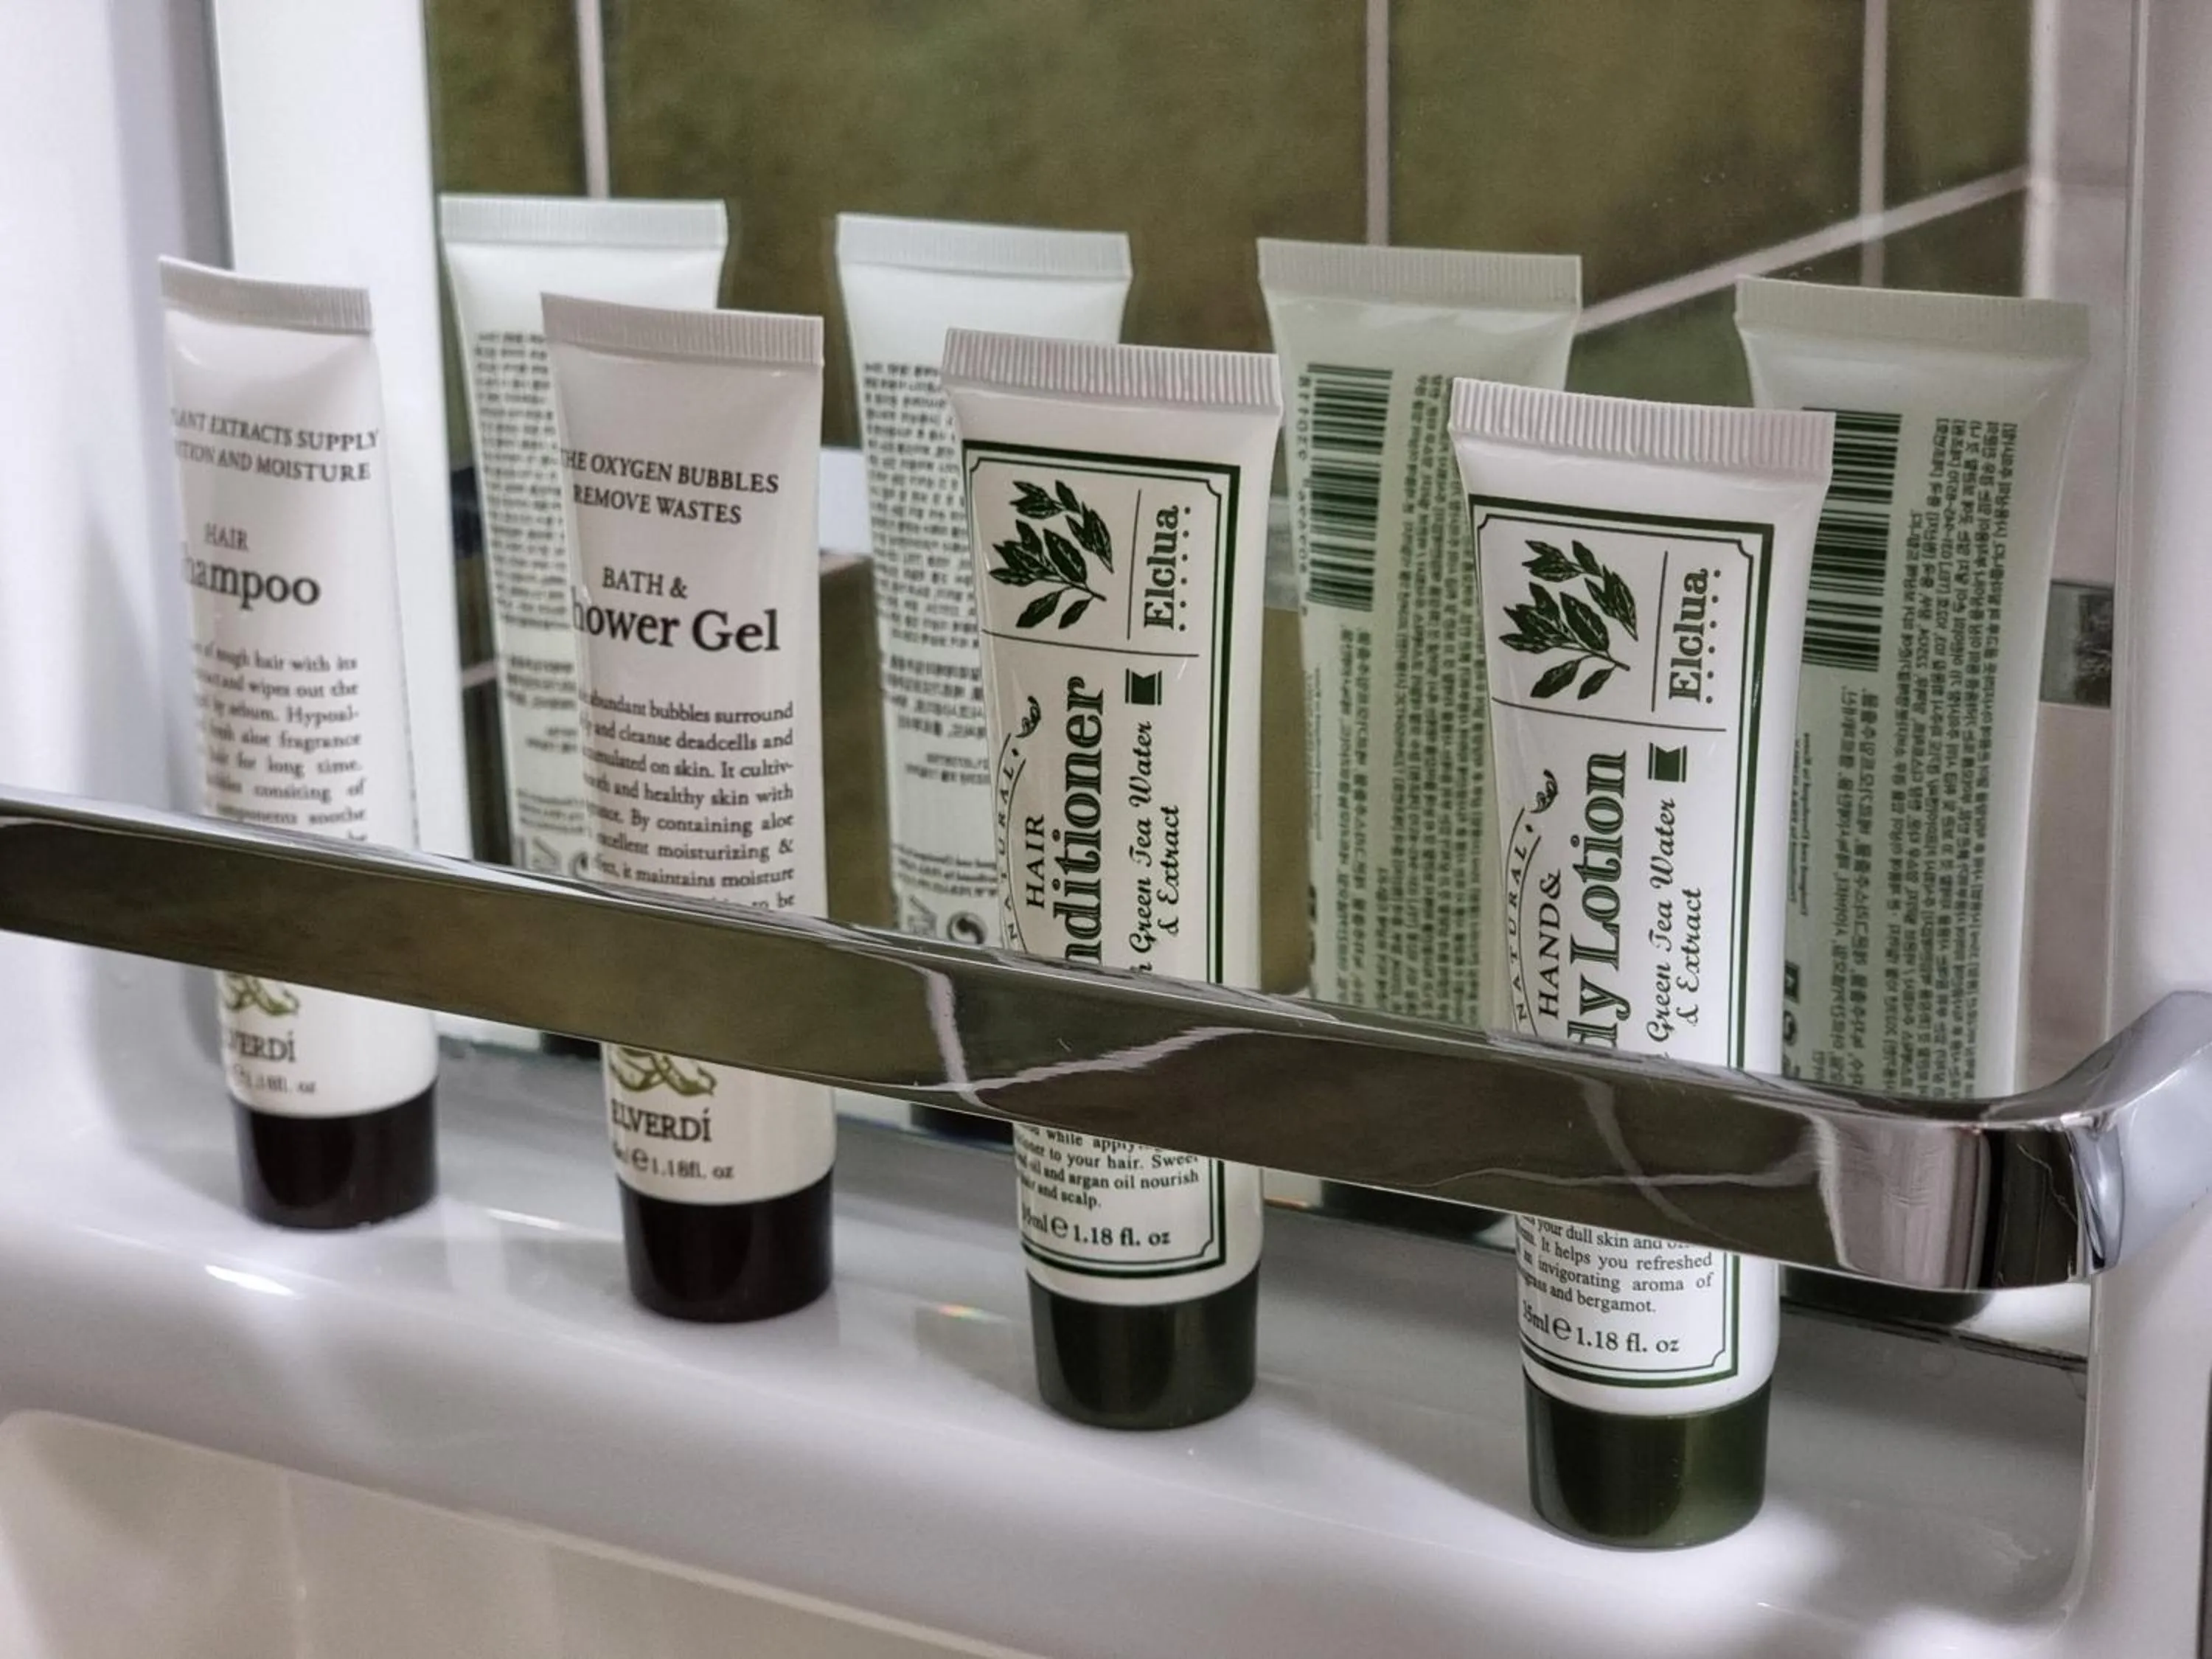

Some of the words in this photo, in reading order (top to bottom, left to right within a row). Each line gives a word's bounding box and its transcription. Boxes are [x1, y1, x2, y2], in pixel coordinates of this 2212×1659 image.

[210, 414, 293, 448] EXTRACTS
[297, 428, 379, 452] SUPPLY
[218, 448, 253, 471] AND
[255, 454, 372, 483] MOISTURE
[591, 453, 673, 484] OXYGEN
[678, 465, 779, 495] BUBBLES
[573, 483, 652, 514] REMOVE
[655, 495, 742, 525] WASTES
[204, 521, 249, 552] HAIR
[602, 566, 664, 597] BATH
[669, 576, 689, 599] &
[692, 608, 781, 653] Gel
[650, 698, 711, 723] bubbles
[714, 700, 794, 724] surround
[618, 723, 672, 748] cleanse
[675, 731, 758, 751] deadcells
[762, 728, 794, 747] and
[650, 760, 671, 776] on
[674, 758, 716, 779] skin.
[720, 761, 735, 779] It
[740, 759, 795, 779] cultiv-
[1127, 720, 1153, 810] Water
[613, 779, 639, 800] and
[644, 782, 706, 810] healthy
[710, 787, 750, 807] skin
[755, 782, 794, 802] with
[630, 807, 650, 832] By
[656, 816, 754, 839] containing
[761, 810, 795, 831] aloe
[657, 844, 771, 864] moisturizing
[778, 837, 795, 855] &
[1128, 815, 1153, 868] Tea
[1156, 804, 1180, 905] Extract
[1649, 796, 1677, 891] Water
[1025, 813, 1046, 910] HAIR
[1570, 749, 1627, 972] Lotion
[636, 867, 716, 888] maintains
[721, 867, 796, 888] moisture
[775, 891, 796, 910] be
[1128, 877, 1157, 955] Green
[1647, 898, 1673, 953] Tea
[1675, 886, 1703, 995] Extract
[1646, 961, 1676, 1043] Green
[1046, 1128, 1083, 1147] while
[712, 1165, 735, 1180] oz
[1049, 1147, 1062, 1162] to
[1067, 1153, 1101, 1169] your
[1107, 1154, 1144, 1170] hair.
[1043, 1164, 1065, 1183] and
[1068, 1172, 1110, 1190] argan
[1113, 1175, 1135, 1190] oil
[1140, 1169, 1199, 1189] nourish
[1037, 1183, 1057, 1200] and
[1060, 1188, 1102, 1211] scalp.
[1073, 1224, 1114, 1246] 1.18
[1119, 1225, 1141, 1247] fl.
[1147, 1230, 1171, 1247] oz
[1537, 1216, 1562, 1237] your
[1565, 1223, 1593, 1245] dull
[1596, 1231, 1629, 1249] skin
[1541, 1237, 1551, 1254] It
[1554, 1241, 1591, 1266] helps
[1598, 1253, 1629, 1271] you
[1635, 1251, 1712, 1271] refreshed
[1537, 1256, 1621, 1293] invigorating
[1632, 1279, 1685, 1292] aroma
[1695, 1271, 1715, 1290] of
[1549, 1283, 1573, 1303] and
[1576, 1289, 1657, 1313] bergamot.
[1576, 1326, 1619, 1351] 1.18
[1626, 1332, 1648, 1353] fl.
[1655, 1338, 1680, 1354] oz
